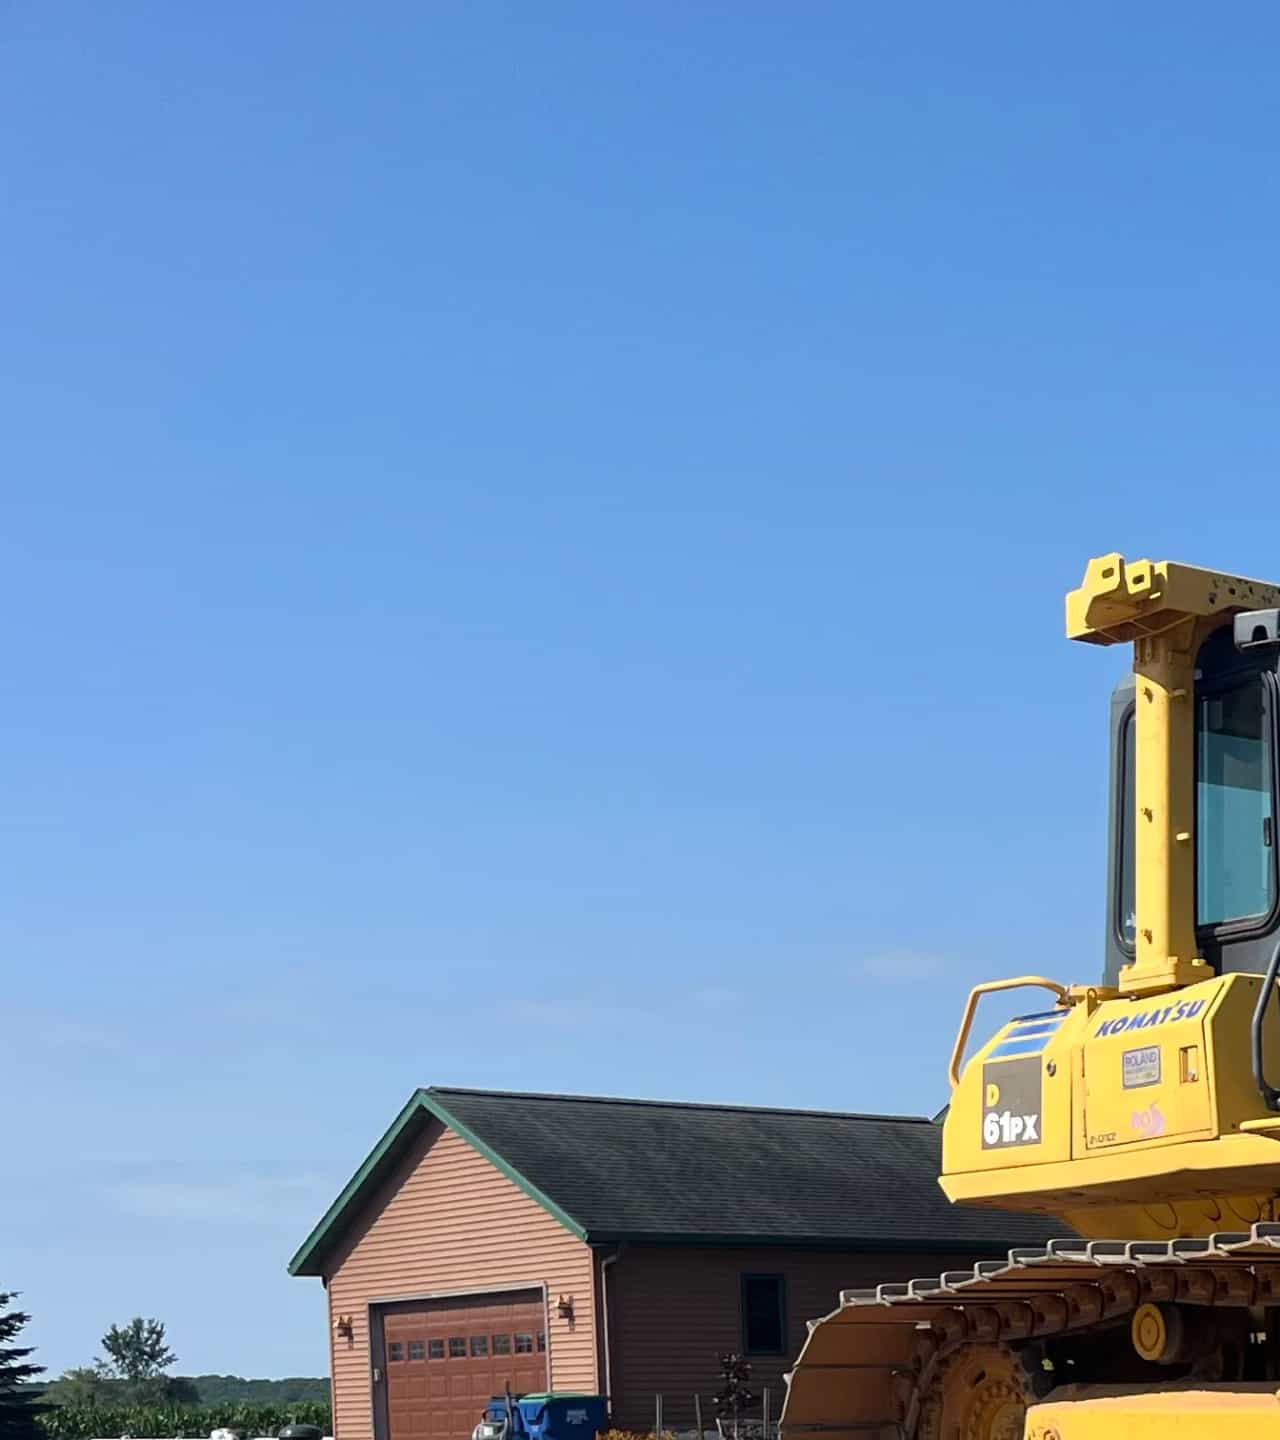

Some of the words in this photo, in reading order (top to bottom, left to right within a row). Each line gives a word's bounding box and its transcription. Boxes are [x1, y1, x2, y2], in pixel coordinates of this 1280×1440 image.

[1094, 999, 1206, 1038] KOMATSU
[986, 1083, 1000, 1107] D
[984, 1111, 1039, 1145] 61PX
